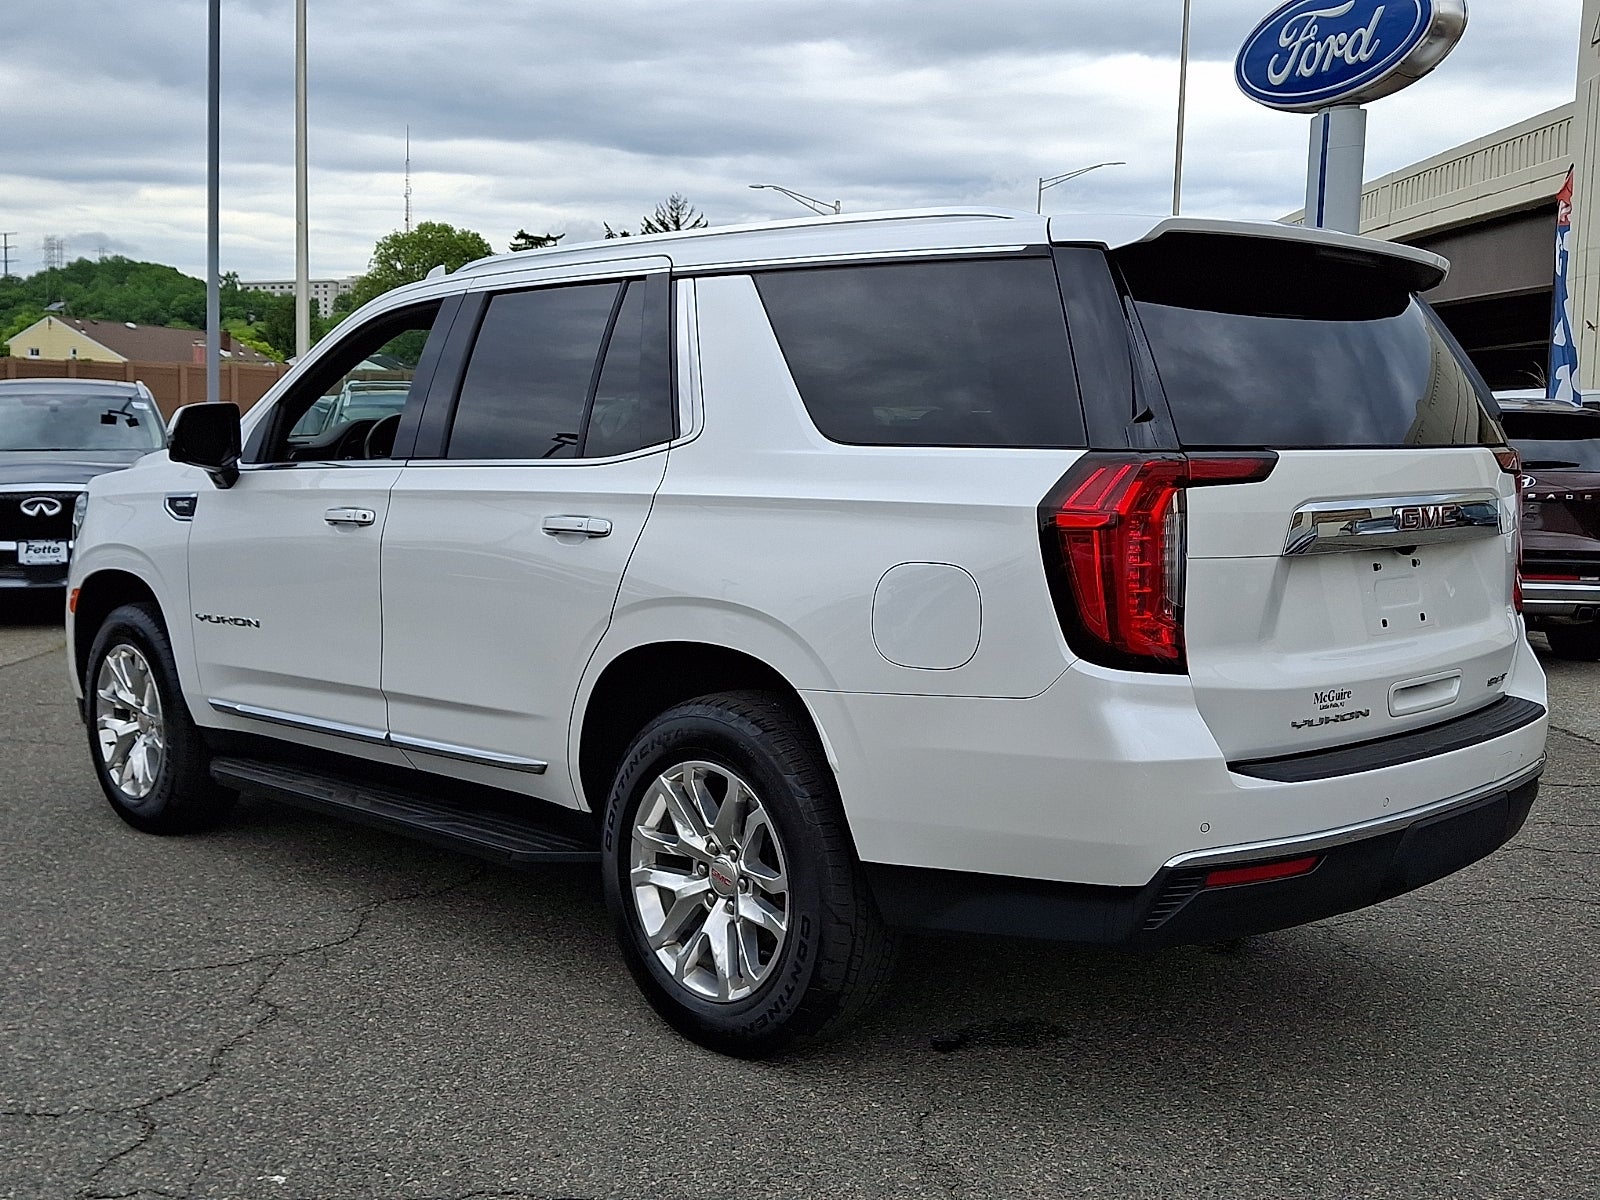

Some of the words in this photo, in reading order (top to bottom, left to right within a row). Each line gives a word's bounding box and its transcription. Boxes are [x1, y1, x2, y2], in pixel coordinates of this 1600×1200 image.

[1267, 0, 1386, 86] Ford
[1400, 505, 1458, 530] GMC
[25, 544, 61, 554] Fette
[195, 613, 260, 628] YUKON
[1313, 688, 1352, 705] McGuire
[1290, 709, 1370, 729] YUKON
